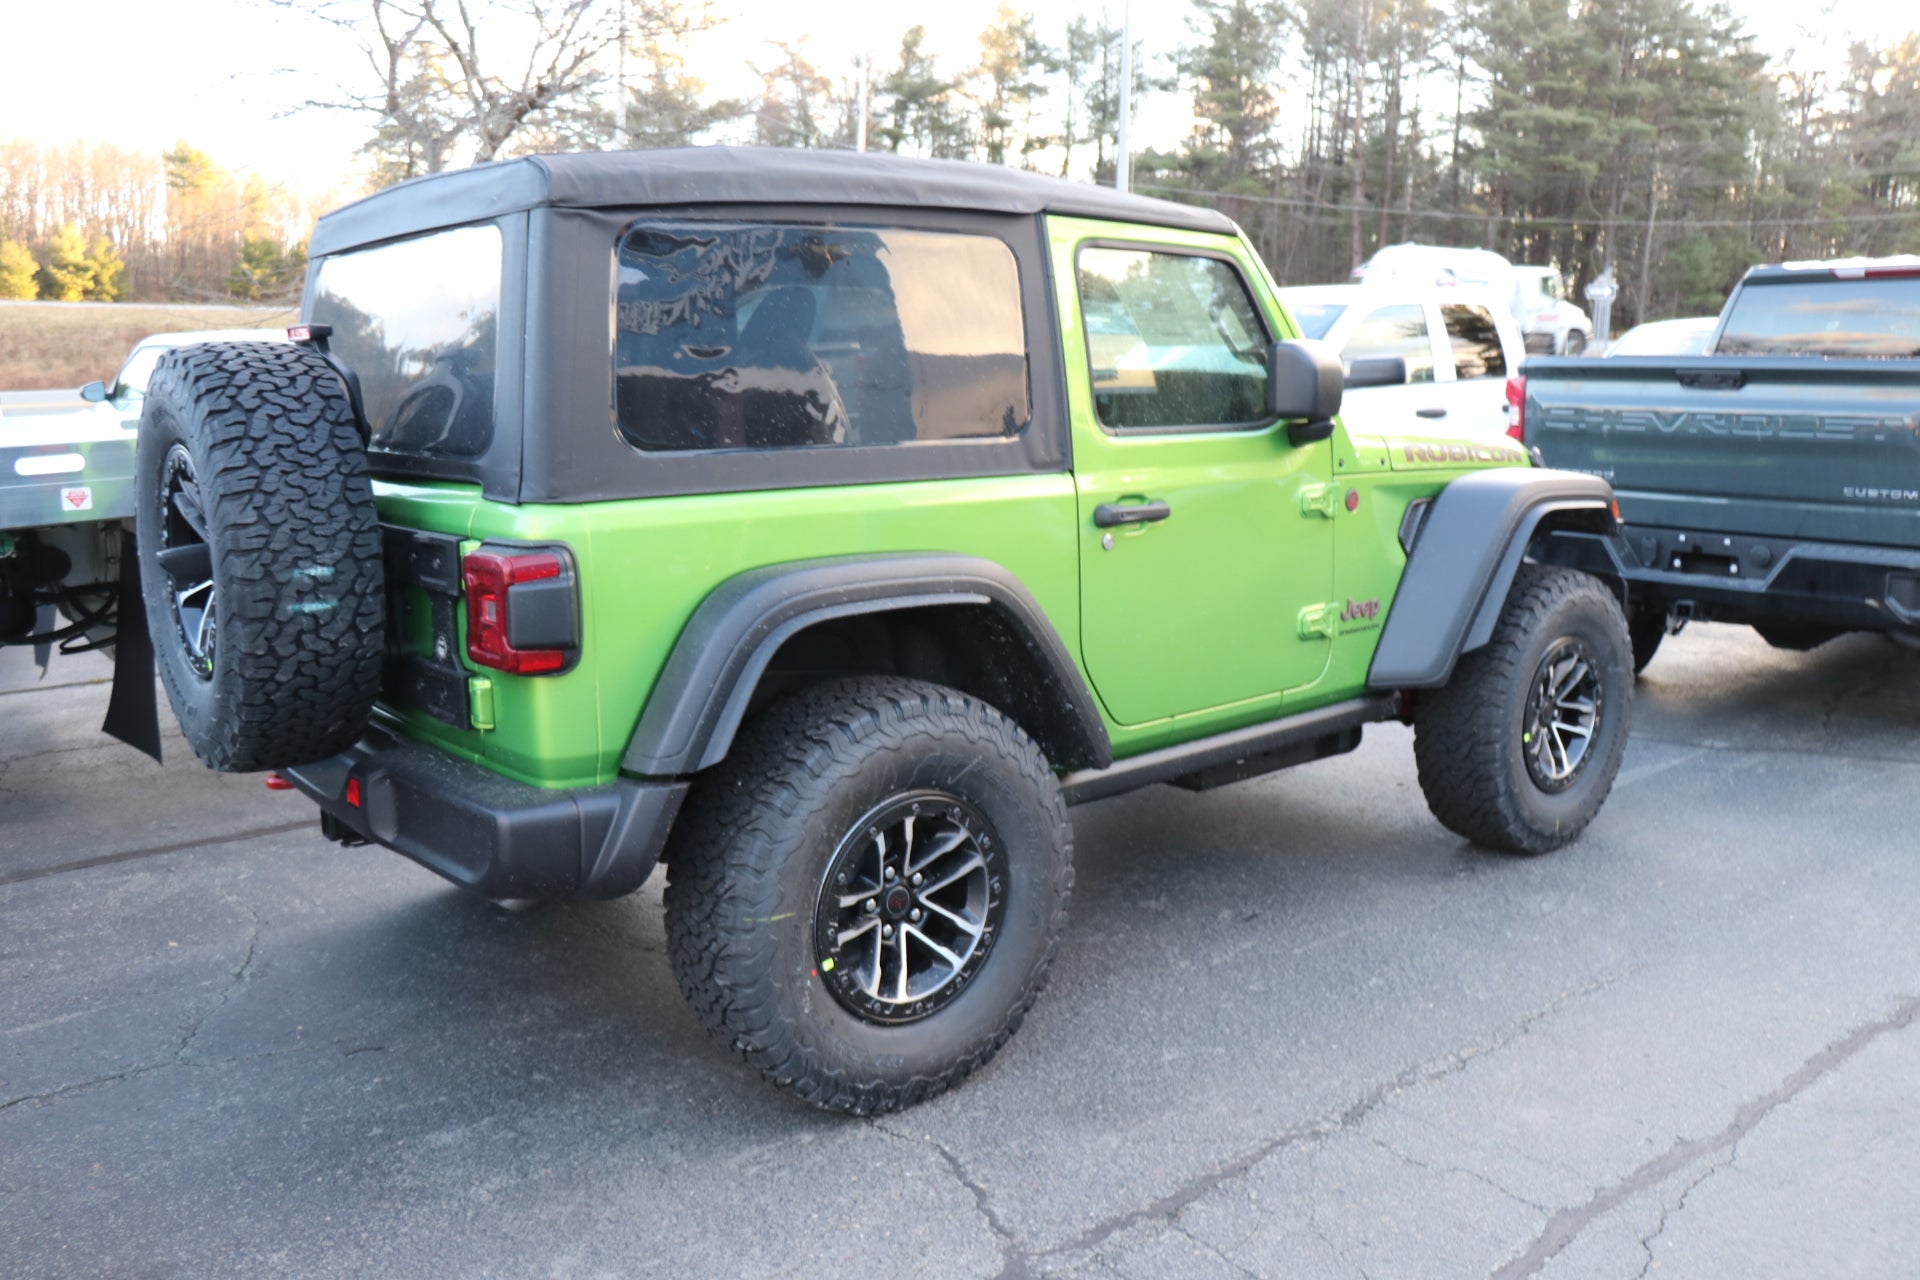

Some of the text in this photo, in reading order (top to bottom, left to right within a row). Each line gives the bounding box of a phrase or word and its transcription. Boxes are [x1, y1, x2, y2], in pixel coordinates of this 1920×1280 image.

[1544, 407, 1905, 441] CHEVROLET
[1404, 444, 1522, 463] RUBICON
[1843, 486, 1919, 500] CUSTOM
[1340, 597, 1380, 622] Jeep
